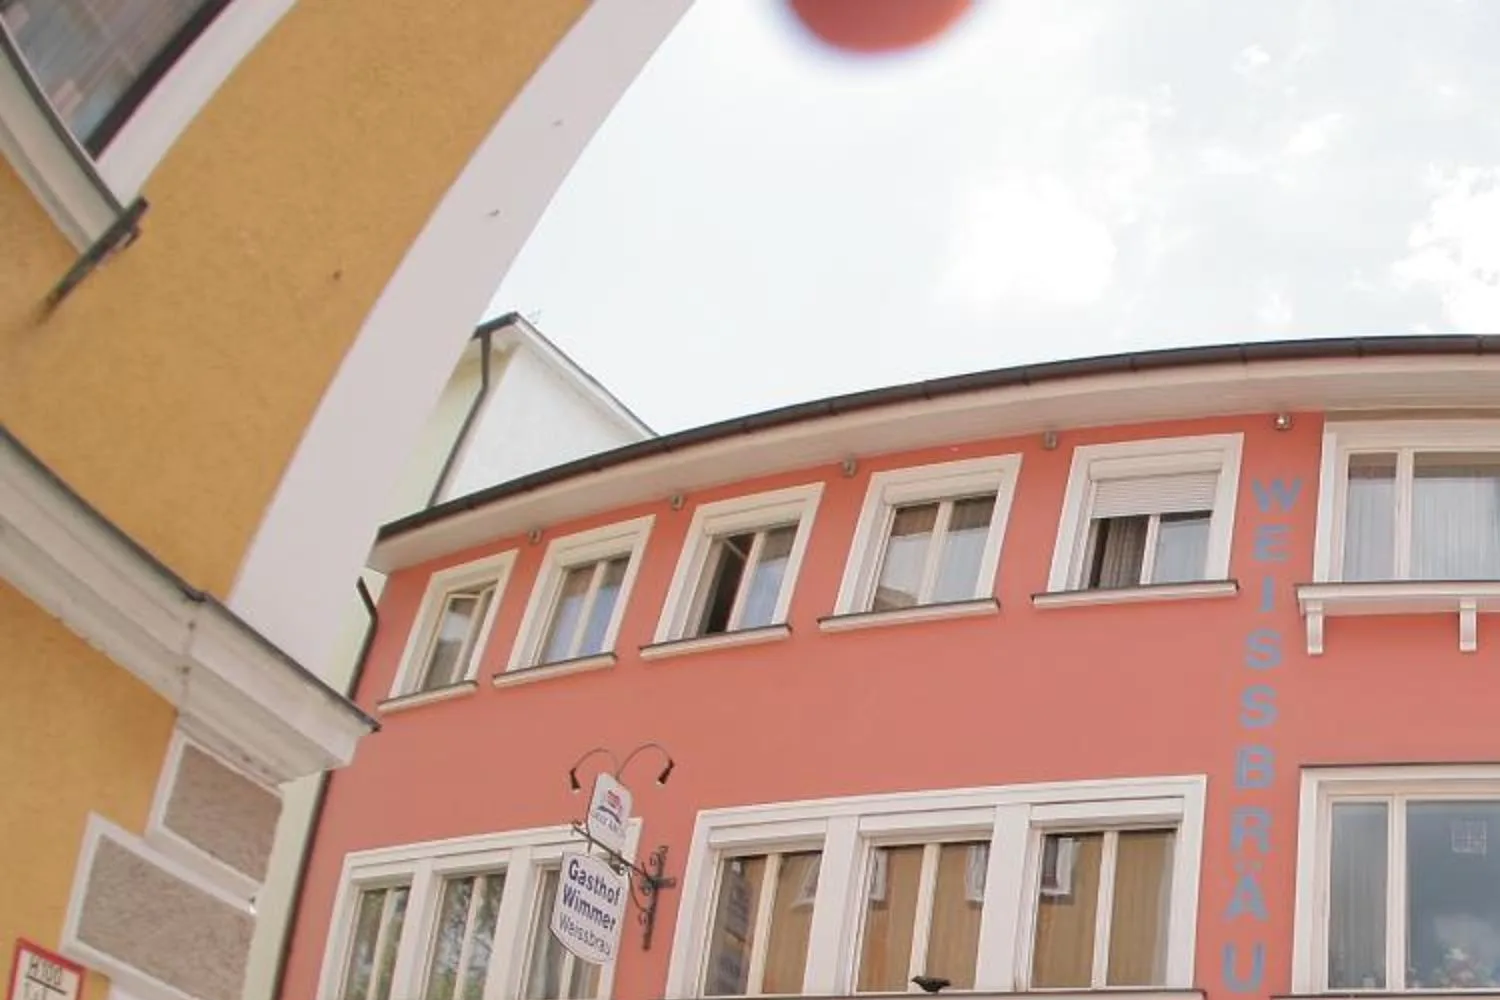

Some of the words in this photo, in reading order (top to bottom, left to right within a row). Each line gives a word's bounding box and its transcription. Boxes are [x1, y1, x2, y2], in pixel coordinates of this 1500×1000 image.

[1221, 477, 1303, 993] WEISSBRÄU
[568, 858, 622, 907] Gasthof
[562, 884, 617, 931] Wimmer
